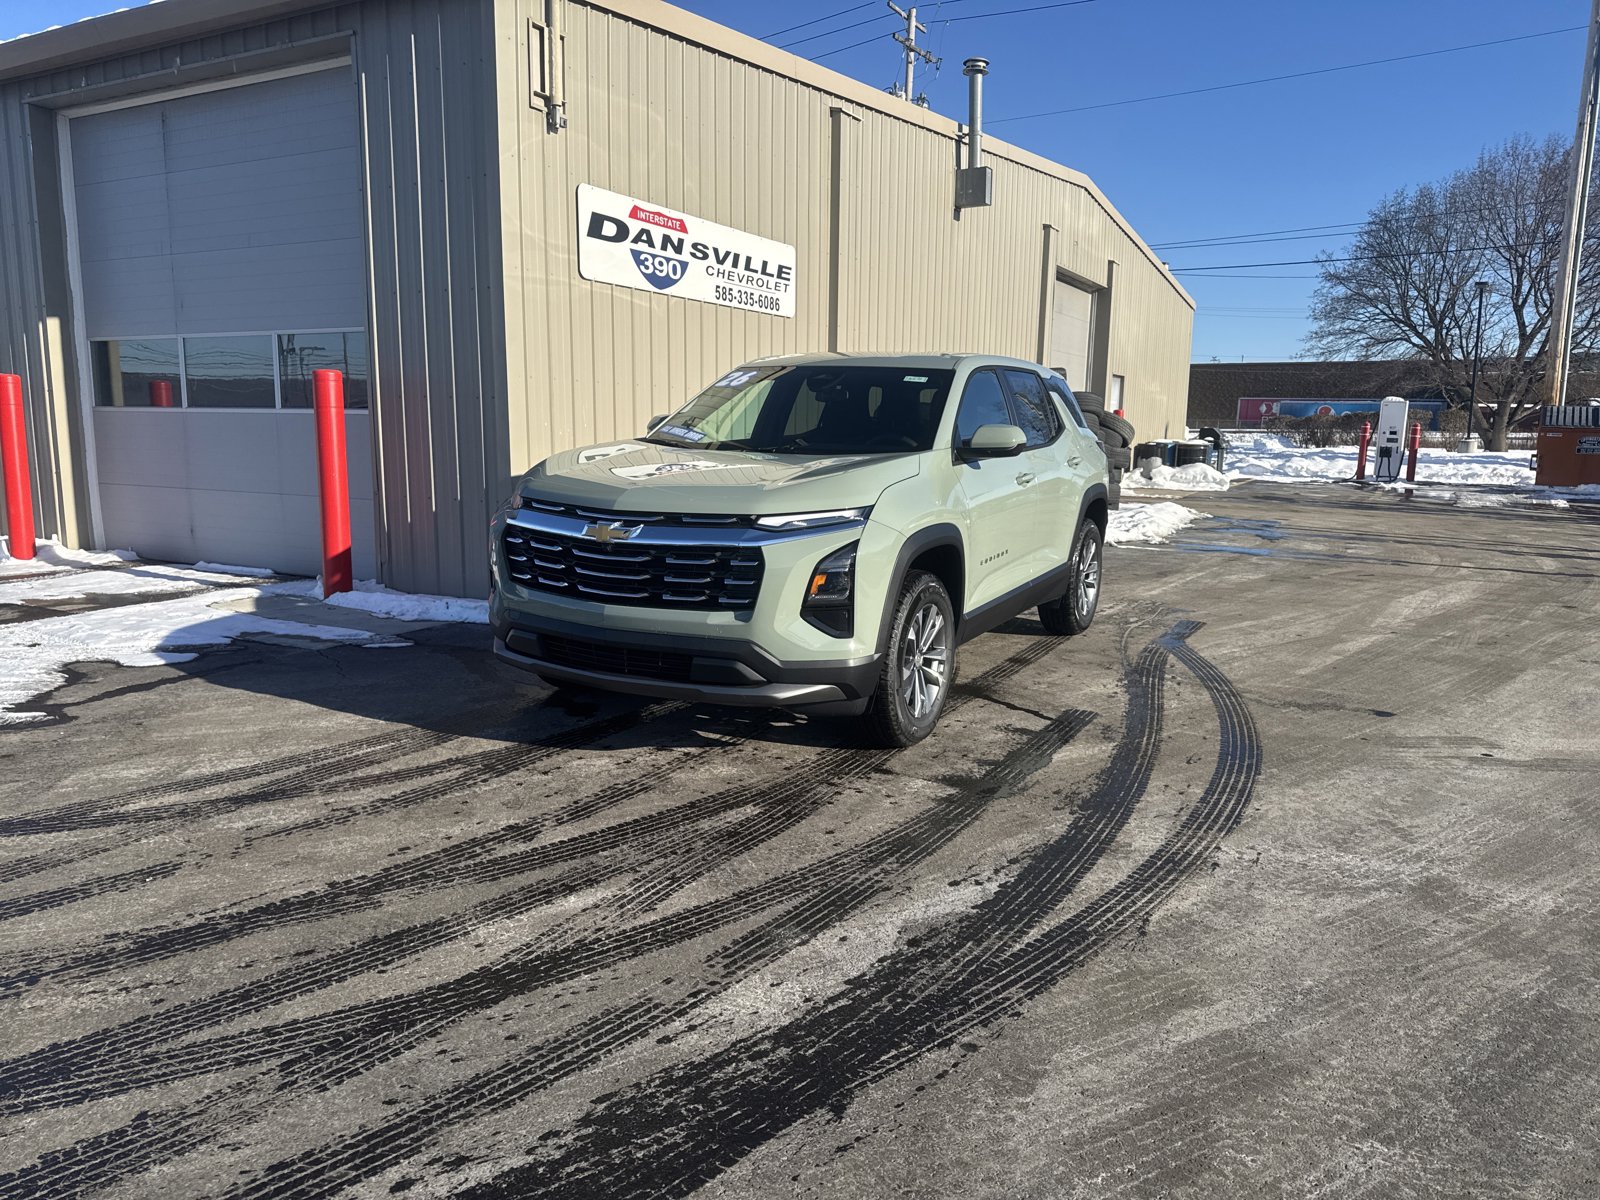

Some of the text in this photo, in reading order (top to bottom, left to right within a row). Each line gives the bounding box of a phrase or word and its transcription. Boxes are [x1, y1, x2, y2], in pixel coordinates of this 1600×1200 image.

[637, 209, 681, 230] INTERSTATE
[587, 211, 792, 282] DANSVILLE
[639, 253, 682, 280] 390
[705, 265, 790, 293] CHEVROLET
[715, 285, 780, 312] 585-335-6086
